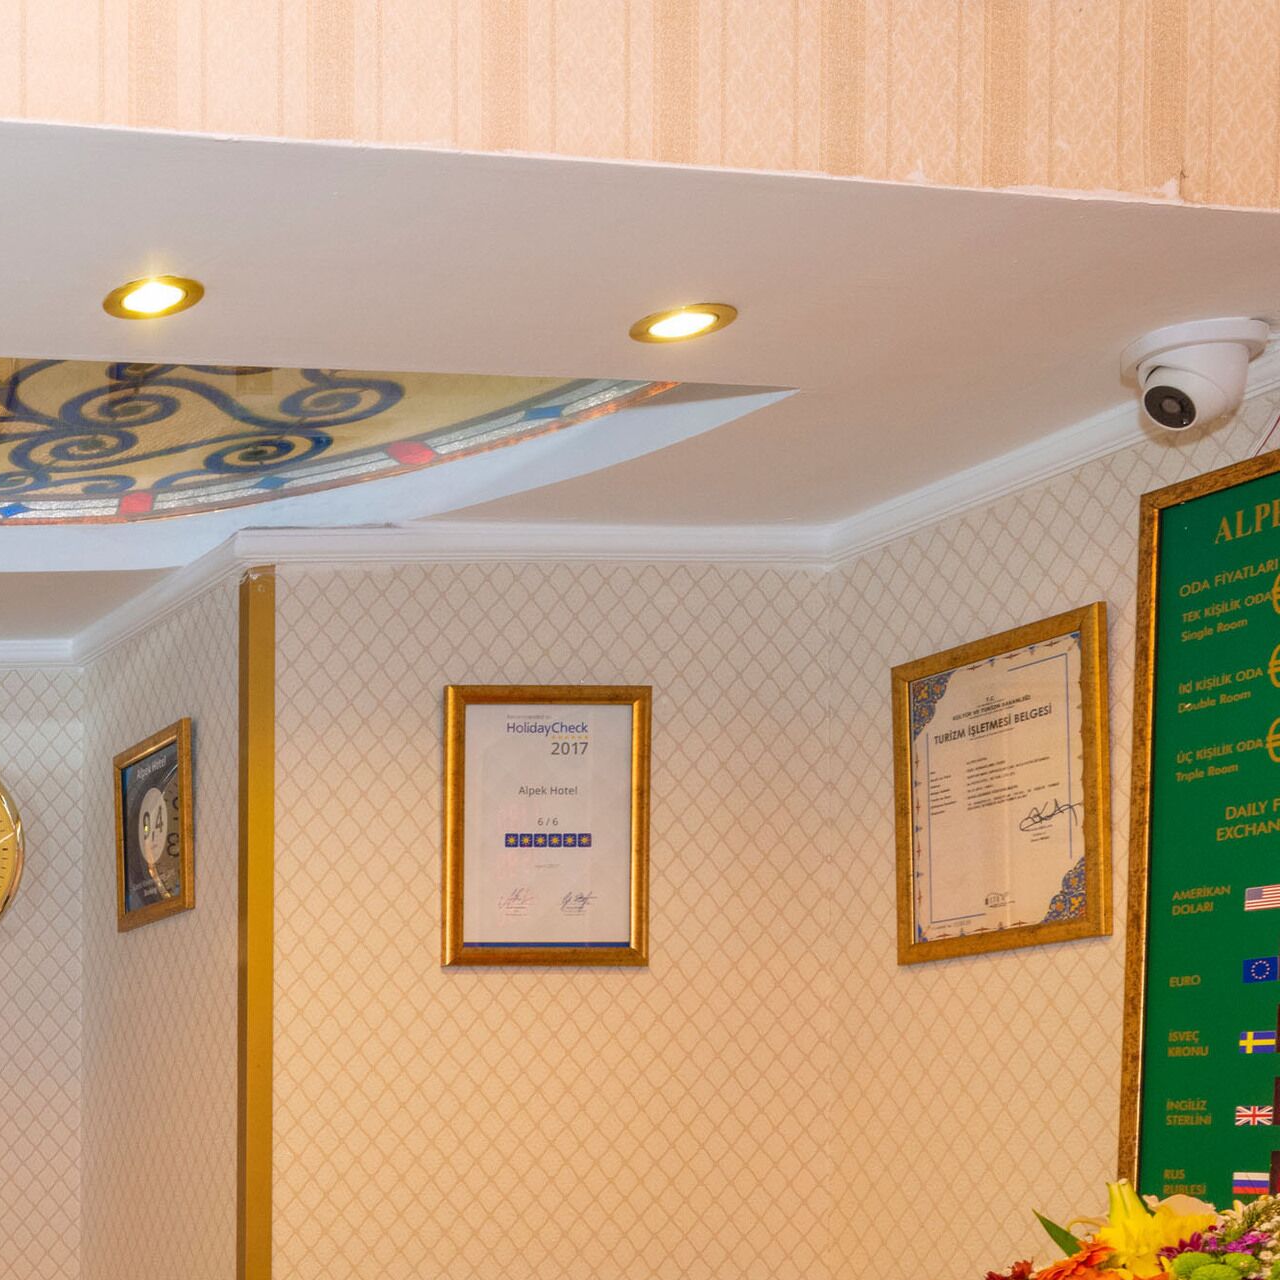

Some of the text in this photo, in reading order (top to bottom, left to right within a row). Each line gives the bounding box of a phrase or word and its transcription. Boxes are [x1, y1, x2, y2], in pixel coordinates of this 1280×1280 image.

[1179, 579, 1210, 597] ODA
[1245, 591, 1271, 607] ODA
[1181, 618, 1248, 642] Single Room
[1236, 667, 1263, 682] ODA
[1219, 690, 1251, 705] Room
[507, 722, 588, 736] HolidayCheck
[934, 730, 966, 744] TURİZM
[968, 713, 1011, 736] İŞLETMESİ
[1014, 703, 1052, 724] BELGESİ
[551, 742, 588, 755] 2017
[1237, 738, 1263, 752] ODA
[1208, 763, 1238, 777] Room
[519, 786, 578, 797] Alpek Hotel
[1225, 800, 1268, 821] DAILY
[537, 817, 543, 826] 6
[552, 817, 558, 826] 6
[1169, 975, 1201, 987] EURO
